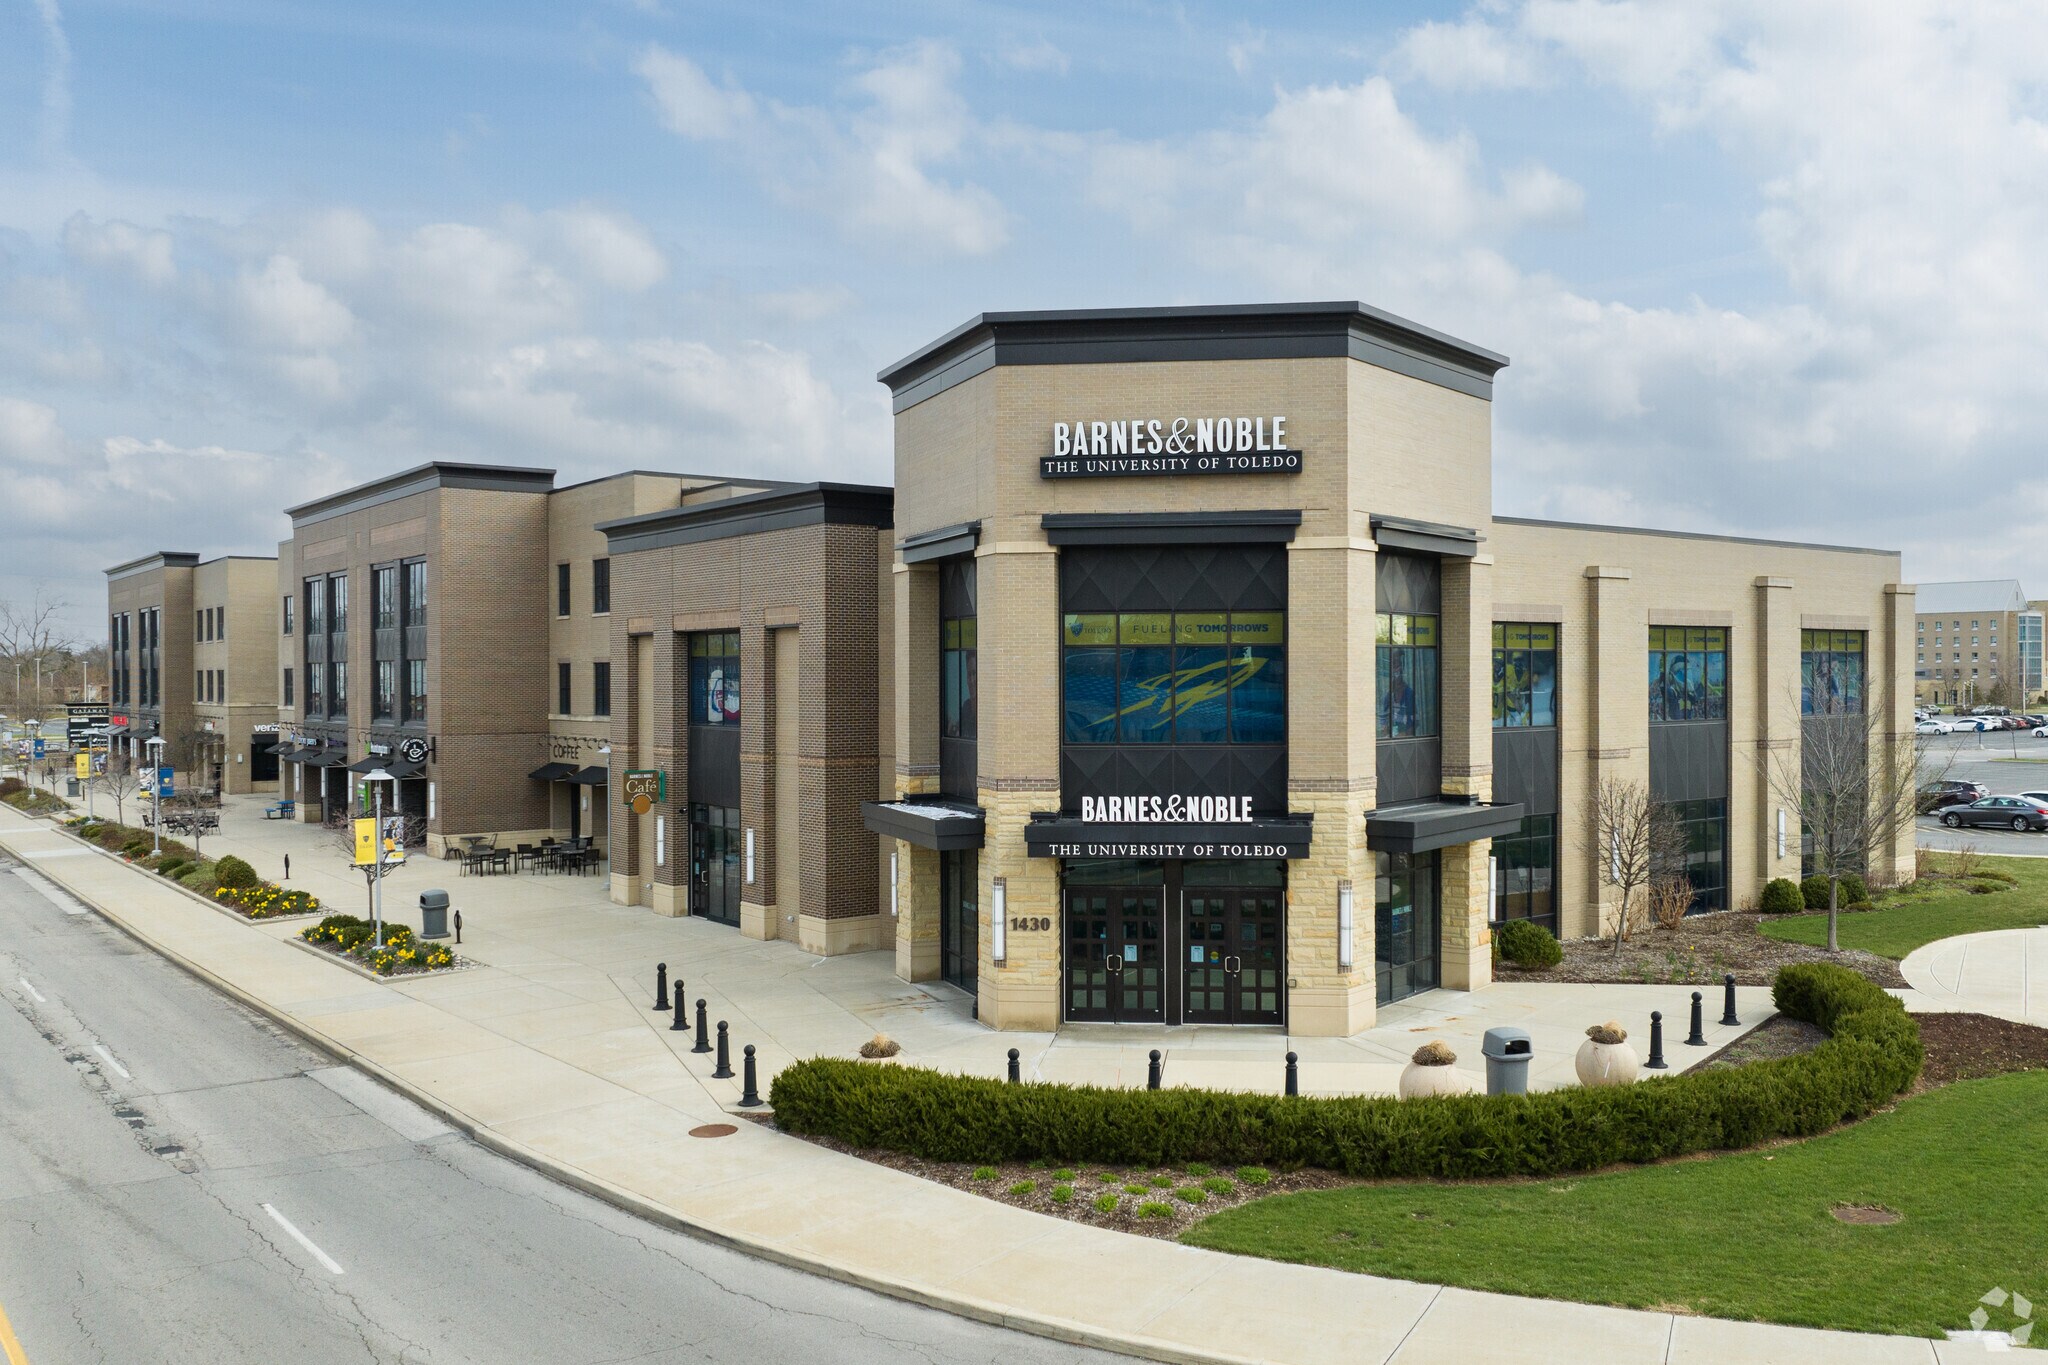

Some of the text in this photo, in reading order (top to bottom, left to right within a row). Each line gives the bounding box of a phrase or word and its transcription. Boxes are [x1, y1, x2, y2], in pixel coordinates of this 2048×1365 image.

[1045, 455, 1298, 473] THE UNIVERSITY OF TOLEDO
[1196, 623, 1269, 633] TOMORROWS
[553, 744, 579, 760] COFFEE
[626, 779, 657, 794] Café
[1048, 843, 1288, 857] THE UNIVERSITY OF TOLEDO
[1010, 917, 1051, 931] 1430
